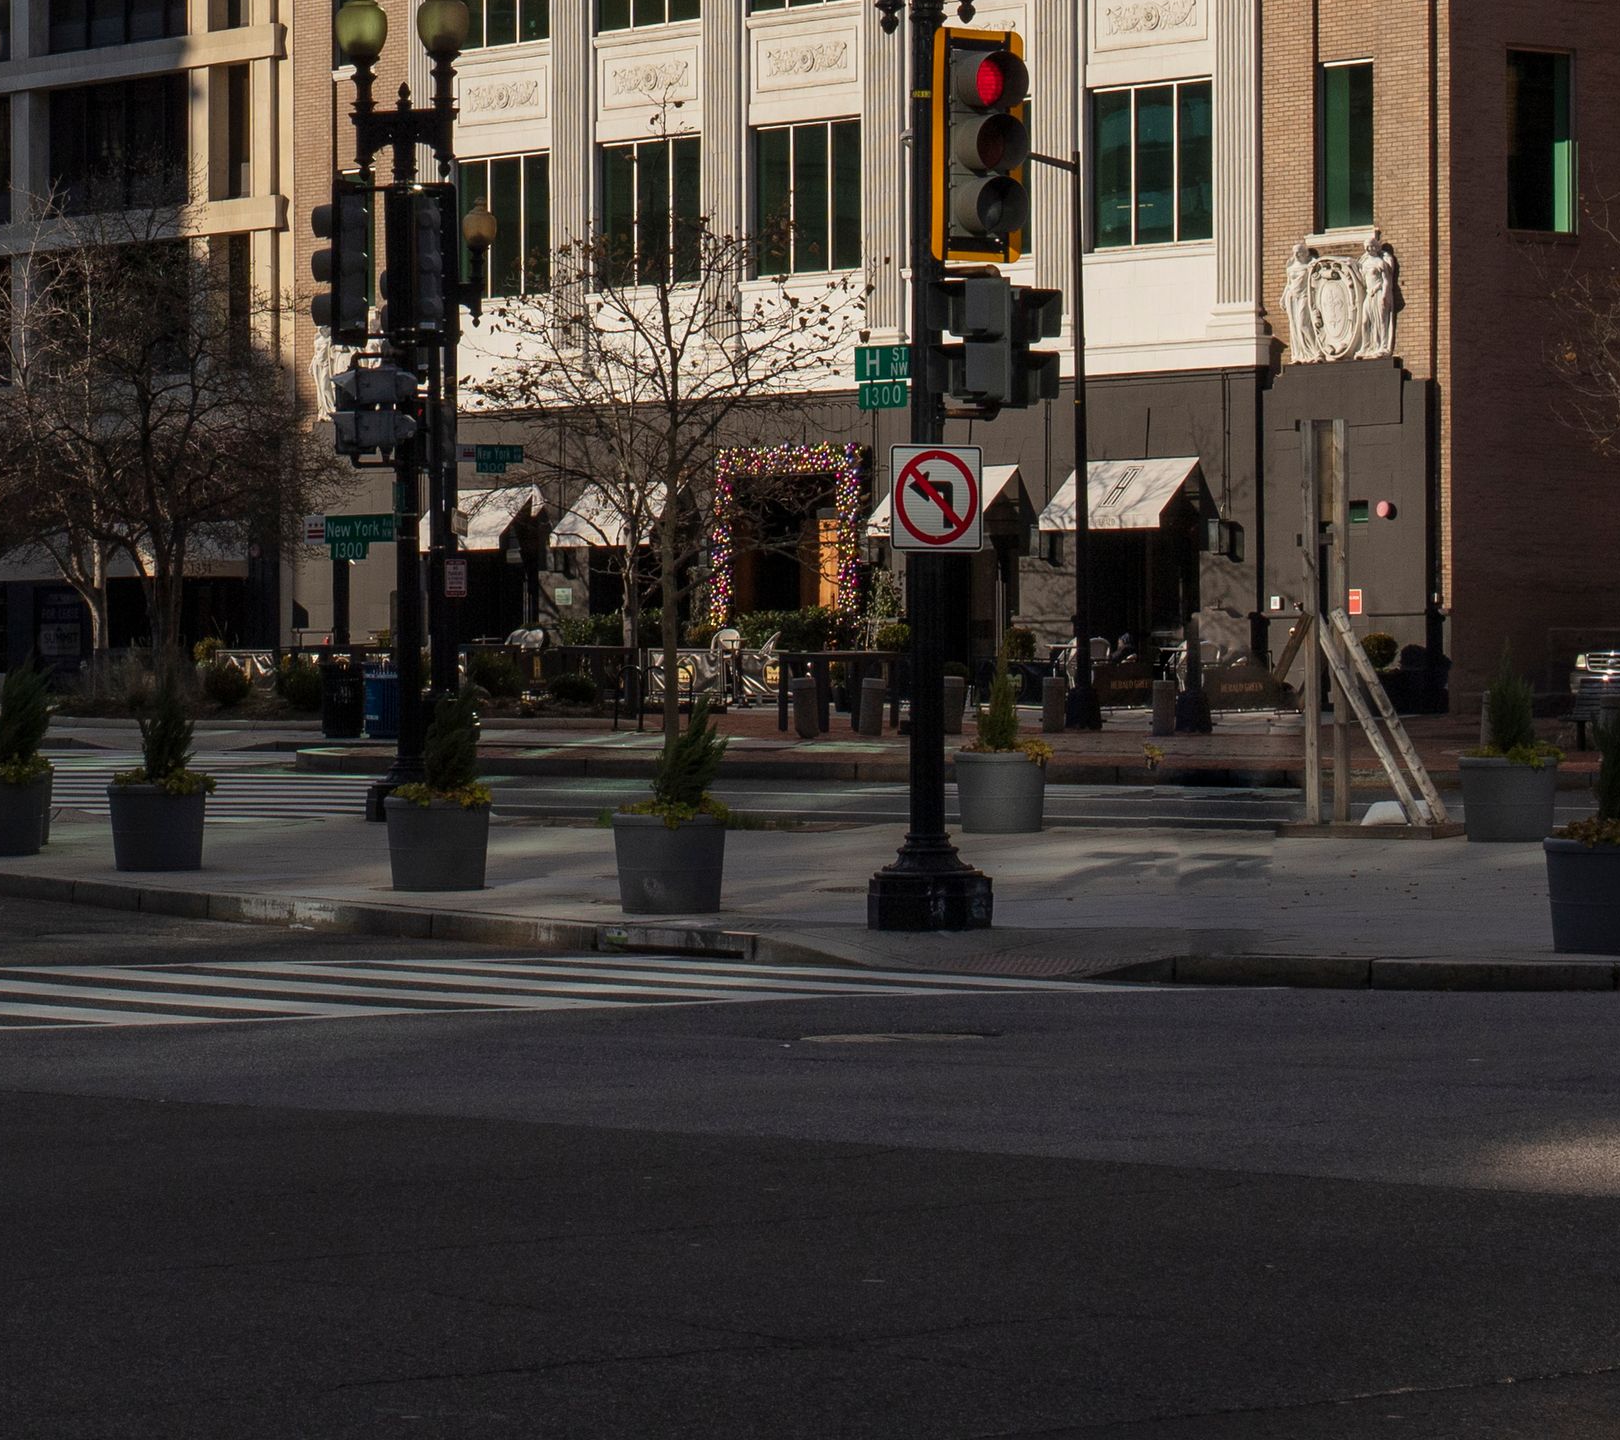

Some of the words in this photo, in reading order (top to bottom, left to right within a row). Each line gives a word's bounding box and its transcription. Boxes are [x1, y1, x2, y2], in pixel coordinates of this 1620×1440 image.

[866, 349, 880, 377] H
[892, 347, 908, 362] ST
[890, 362, 908, 377] NW
[865, 384, 902, 407] 1300
[326, 522, 352, 539] New
[353, 520, 381, 537] York
[335, 542, 364, 559] 1300
